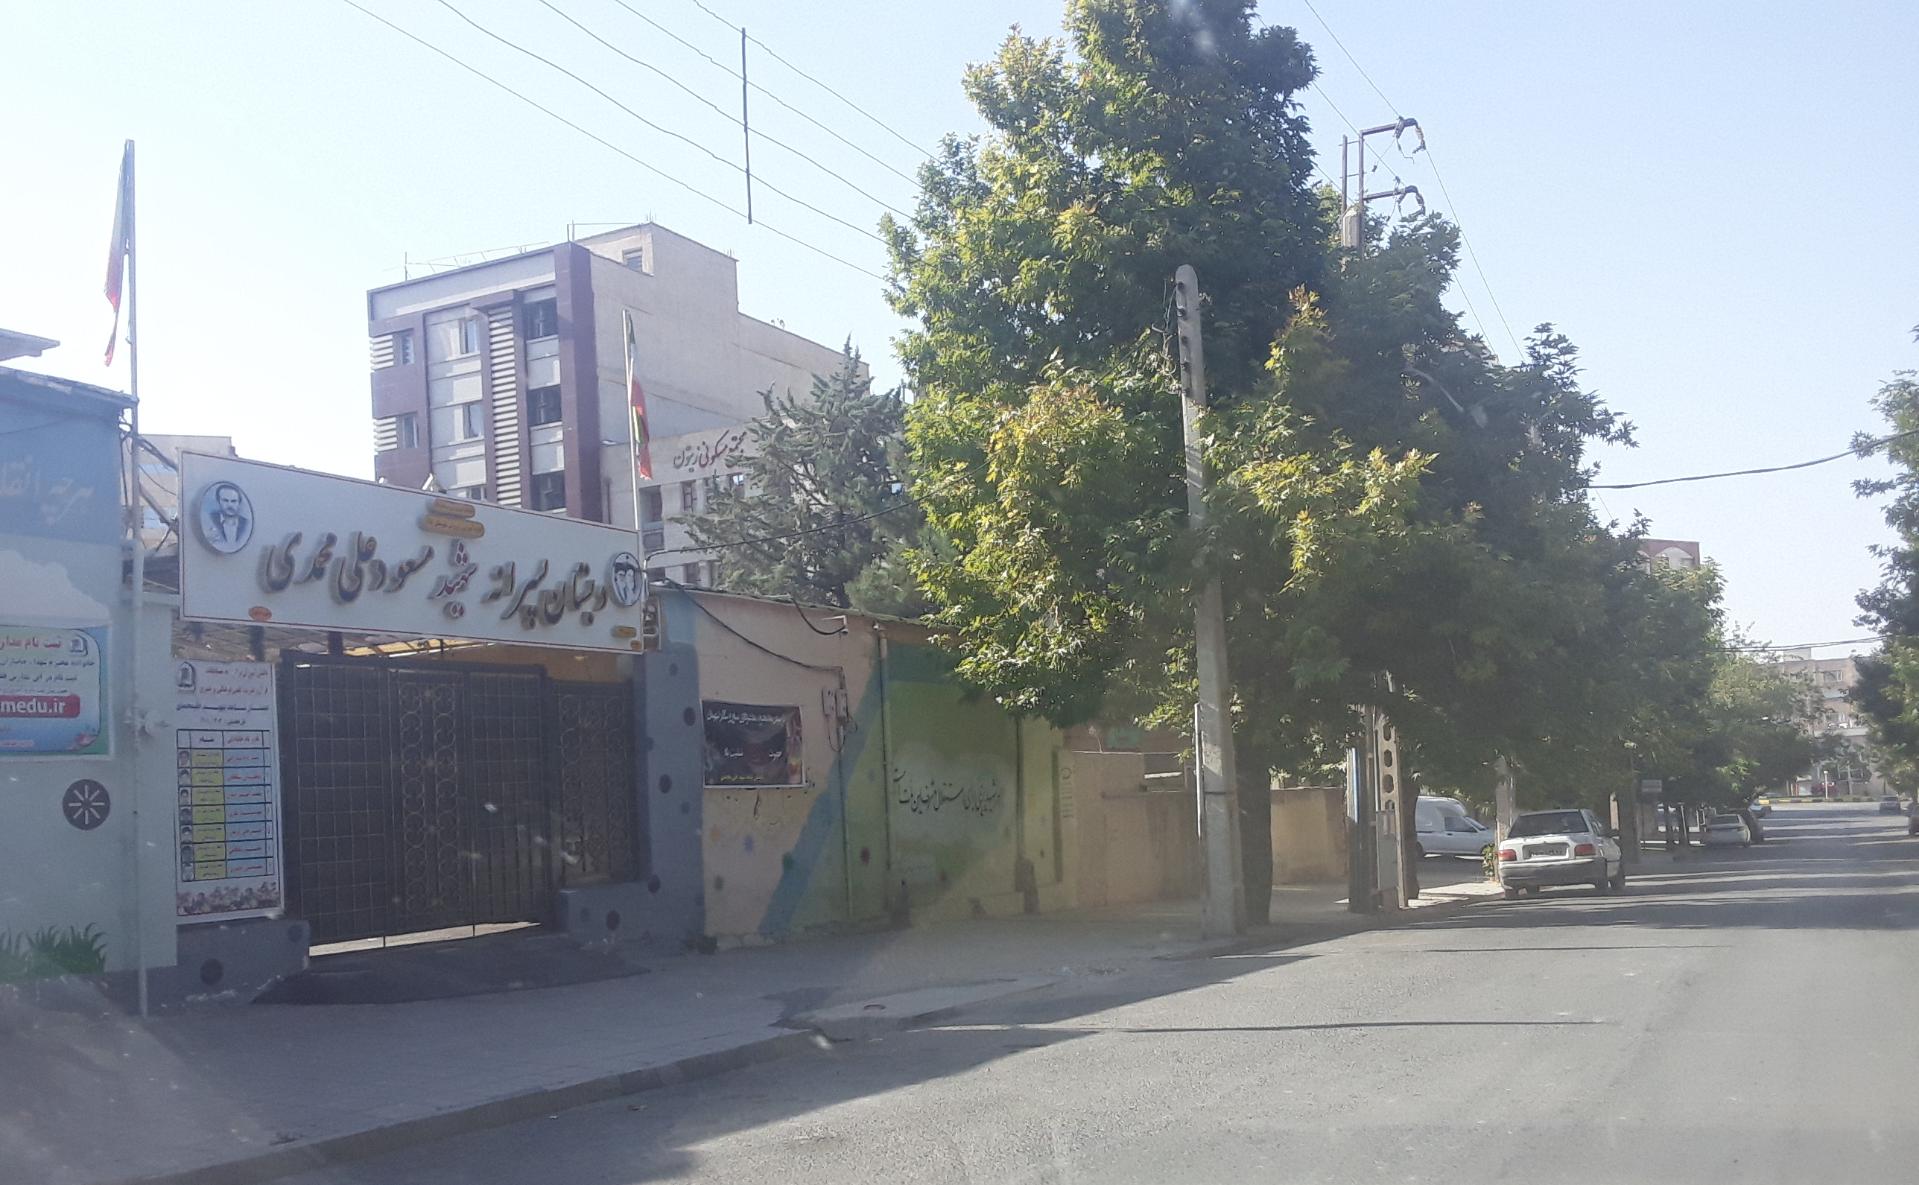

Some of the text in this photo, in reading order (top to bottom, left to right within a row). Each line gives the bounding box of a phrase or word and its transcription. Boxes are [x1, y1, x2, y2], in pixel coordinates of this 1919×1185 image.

[673, 445, 700, 473] زیتون
[698, 429, 729, 468] مسکونی
[257, 530, 608, 631] دبستان پسرانه شهید مسعود علی محمدی
[0, 636, 21, 651] مدار
[0, 698, 66, 713] medu.ir
